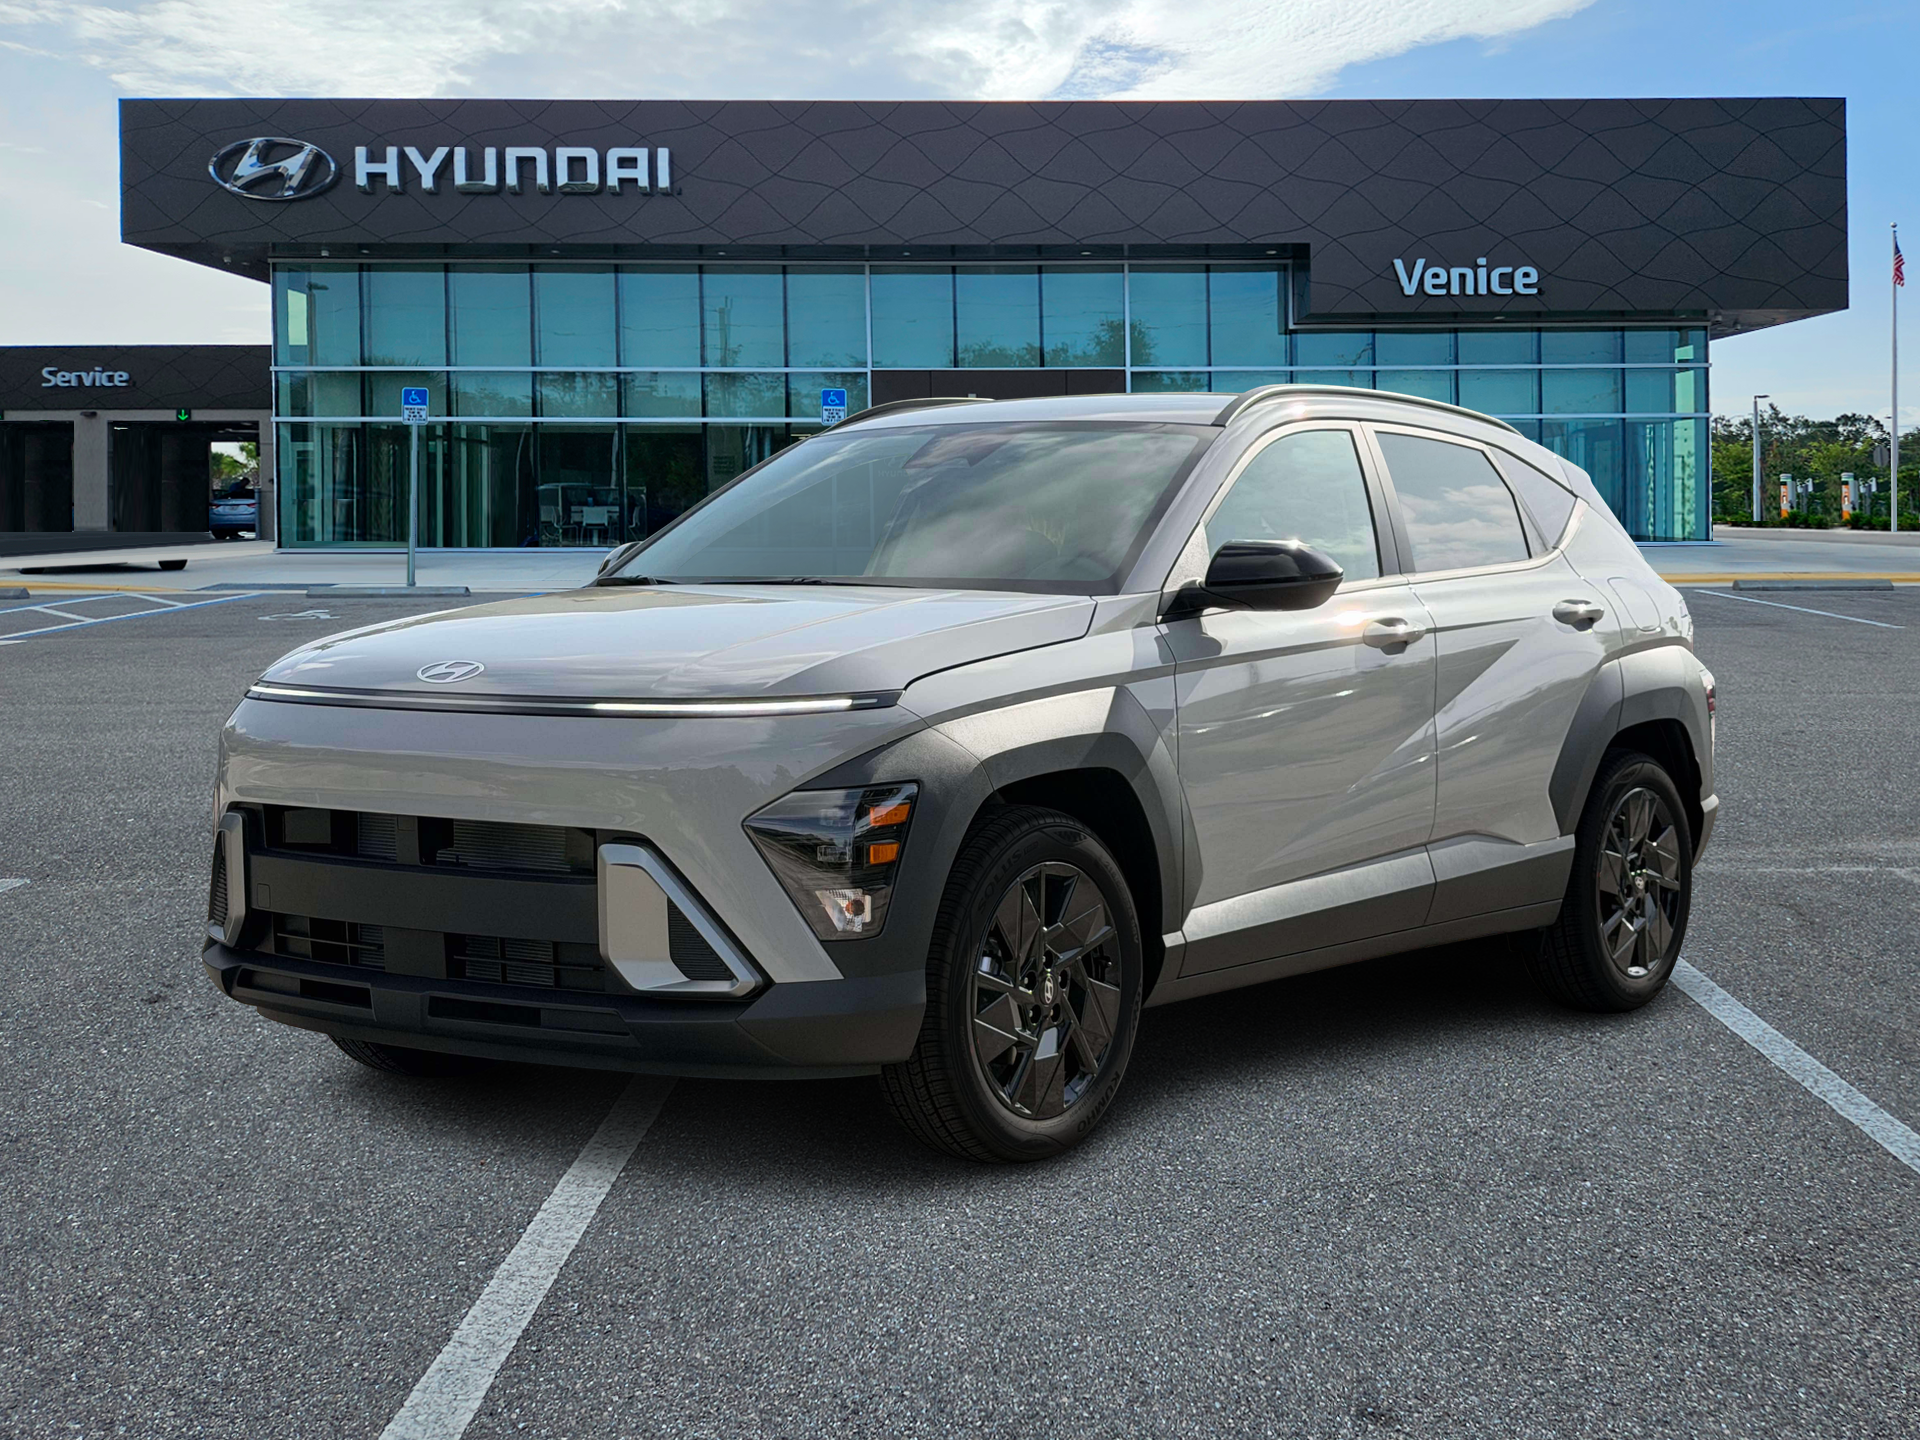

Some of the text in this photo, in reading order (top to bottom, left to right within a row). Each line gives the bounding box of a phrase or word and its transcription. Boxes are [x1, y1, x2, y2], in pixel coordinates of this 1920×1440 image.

[354, 145, 672, 194] HYUNDAI
[1393, 257, 1539, 296] Venice
[41, 366, 130, 388] Service
[977, 848, 1023, 915] SOLUS
[1077, 1070, 1121, 1133] KUMHO
